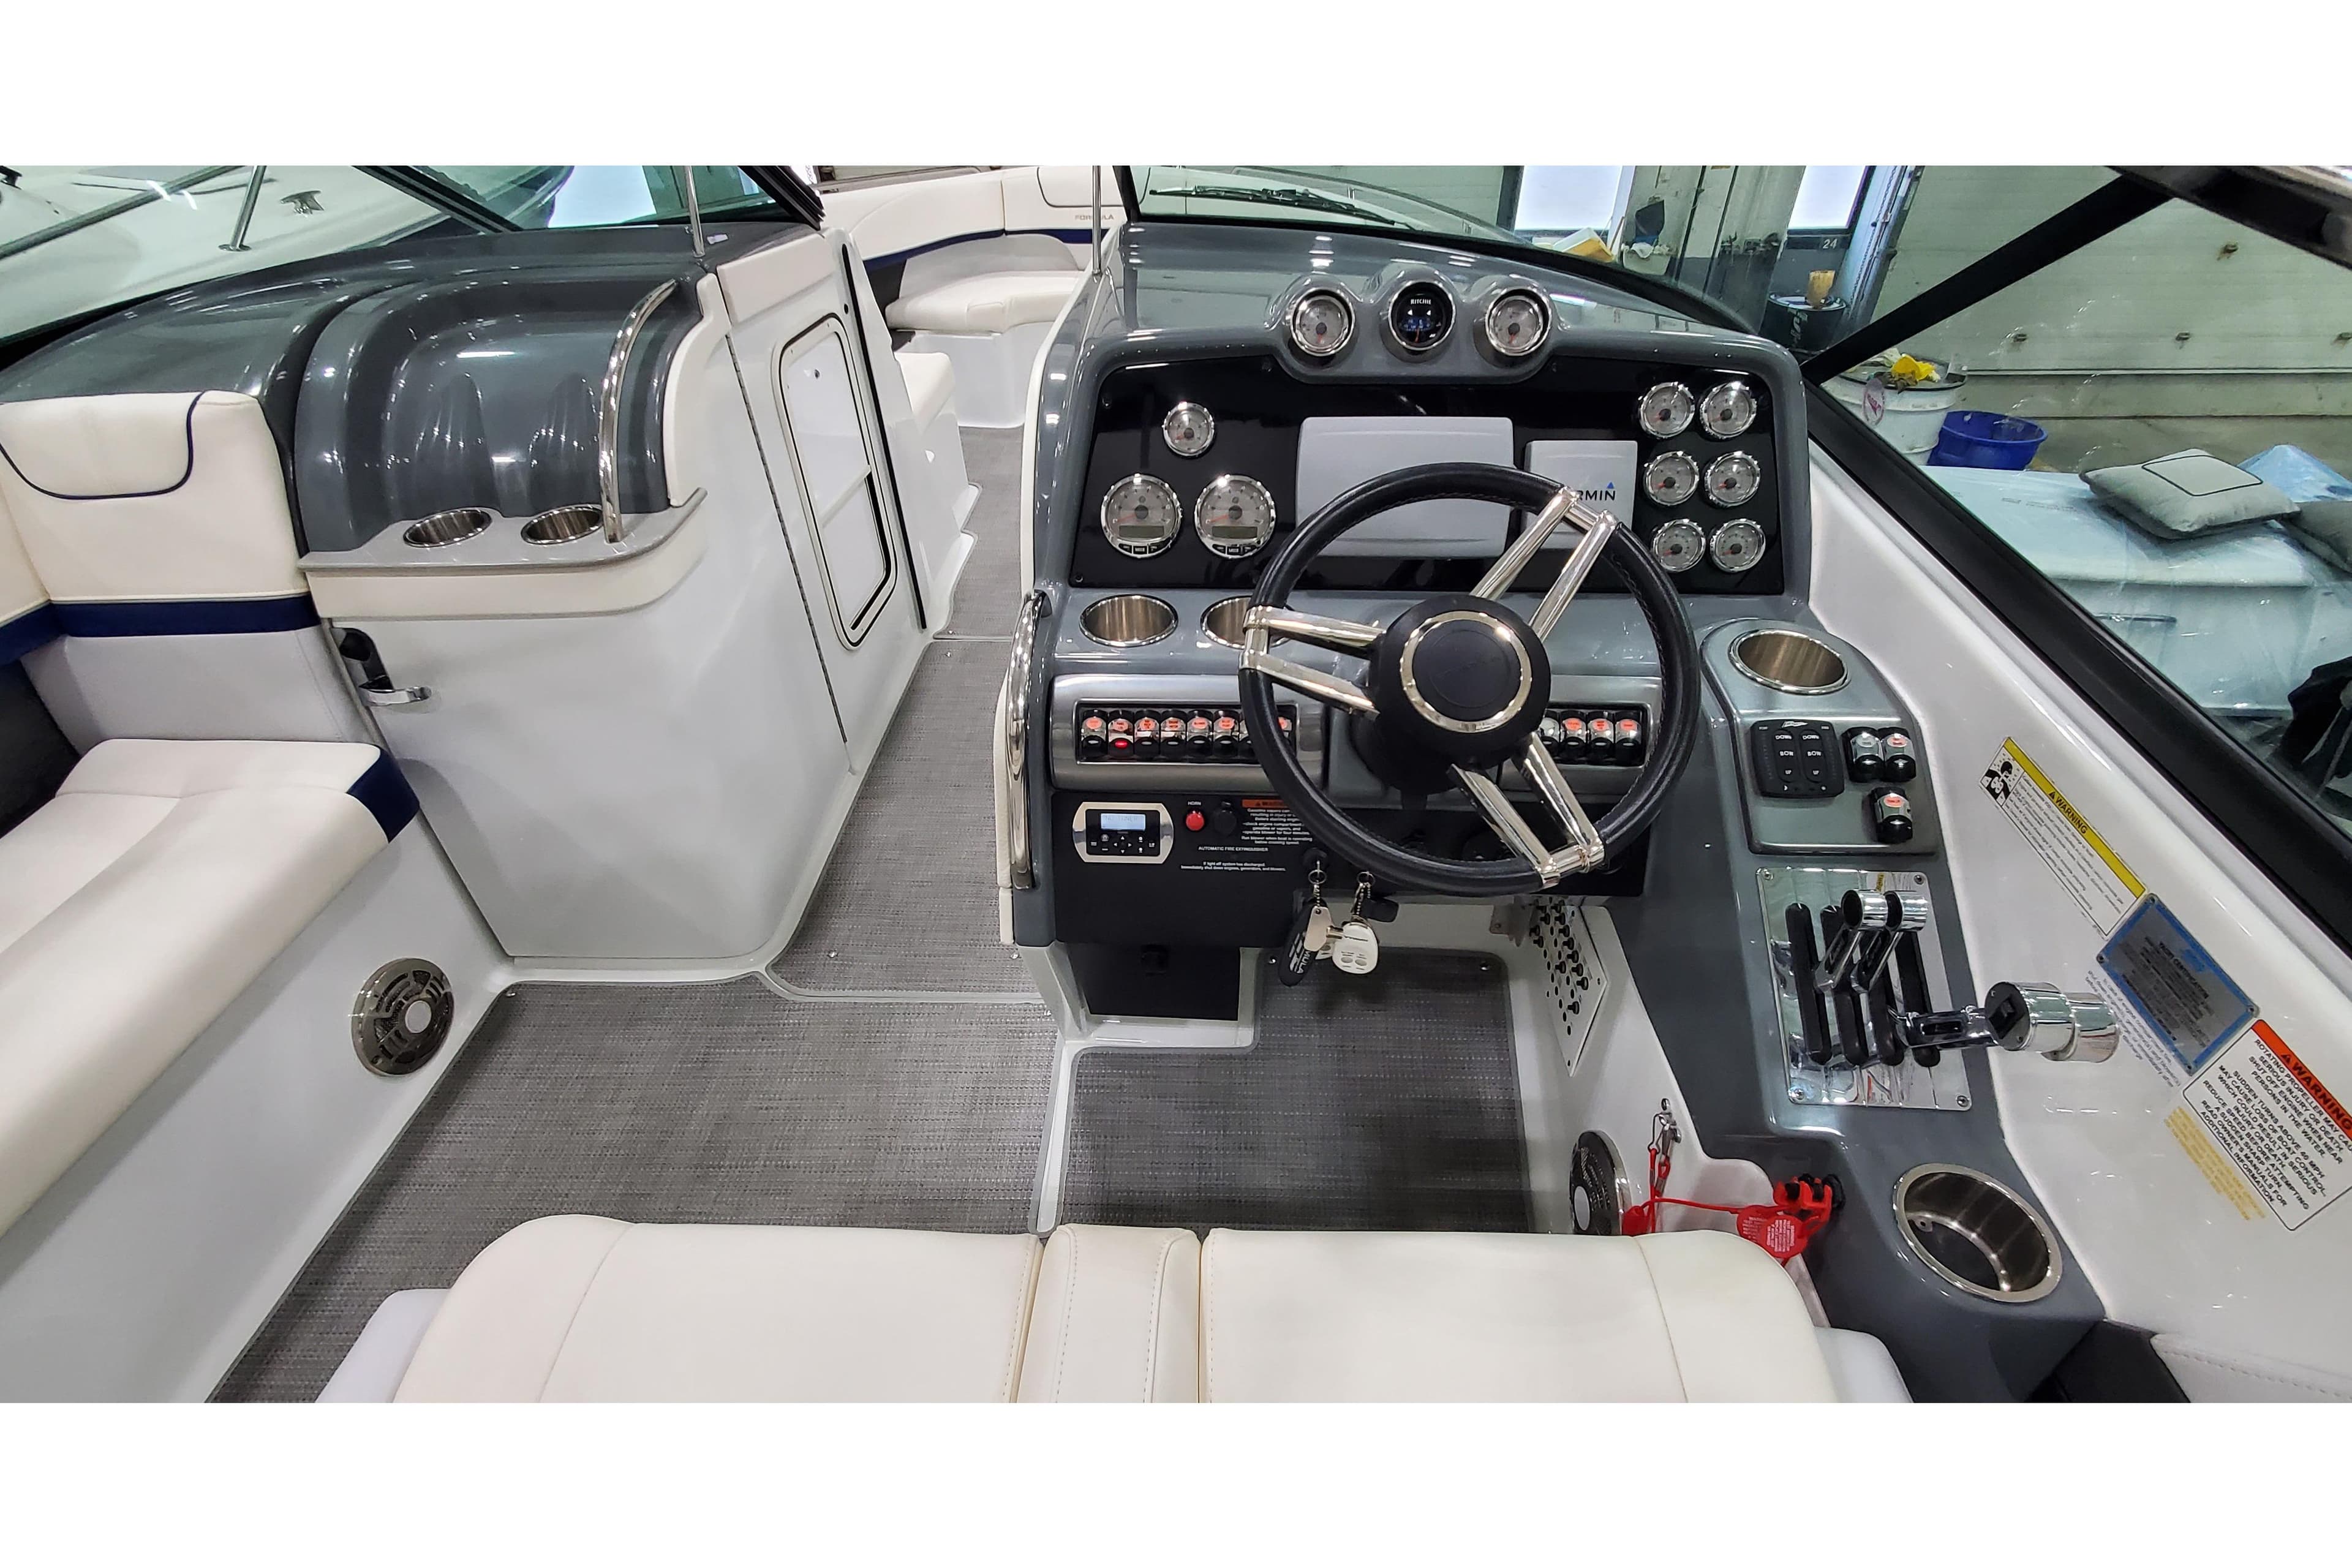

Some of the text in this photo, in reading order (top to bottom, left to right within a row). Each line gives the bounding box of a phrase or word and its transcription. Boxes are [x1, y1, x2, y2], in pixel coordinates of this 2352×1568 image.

[1823, 239, 1838, 249] 24
[1577, 490, 1615, 500] RMIN
[2054, 795, 2088, 835] WARNING
[1297, 951, 1311, 973] MULA
[2231, 1104, 2256, 1133] INJURY
[2253, 1129, 2265, 1144] OR
[2232, 1069, 2326, 1180] SUDDEN TURNS ABOVE 40 MPH
[2247, 1054, 2343, 1165] SHUT OFF ENGINE WHEN NEAR
[2250, 1069, 2327, 1158] PERSONS IN THE WATER.
[2253, 1038, 2352, 1152] ROTATING PROPELLER MAY CAU
[2258, 1054, 2287, 1088] SERIOUS
[2285, 1085, 2310, 1114] INJURY
[2307, 1111, 2321, 1126] OR
[2291, 1061, 2352, 1132] WARNING
[2199, 1109, 2235, 1153] ADDITIONAL
[2200, 1099, 2288, 1208] READ OWNER'S MANUALS FOR
[2202, 1079, 2310, 1211] REDUCE SPEED BEFORE ATTEMPTING
[2213, 1104, 2221, 1113] A
[2218, 1110, 2245, 1142] SUDDEN
[2242, 1140, 2266, 1168] SHARP
[2216, 1074, 2318, 1196] WHICH COULD RESULT IN SERIOUS
[2217, 1064, 2329, 1197] MAY CAUSE LOSS OF BOAT CONTROL,
